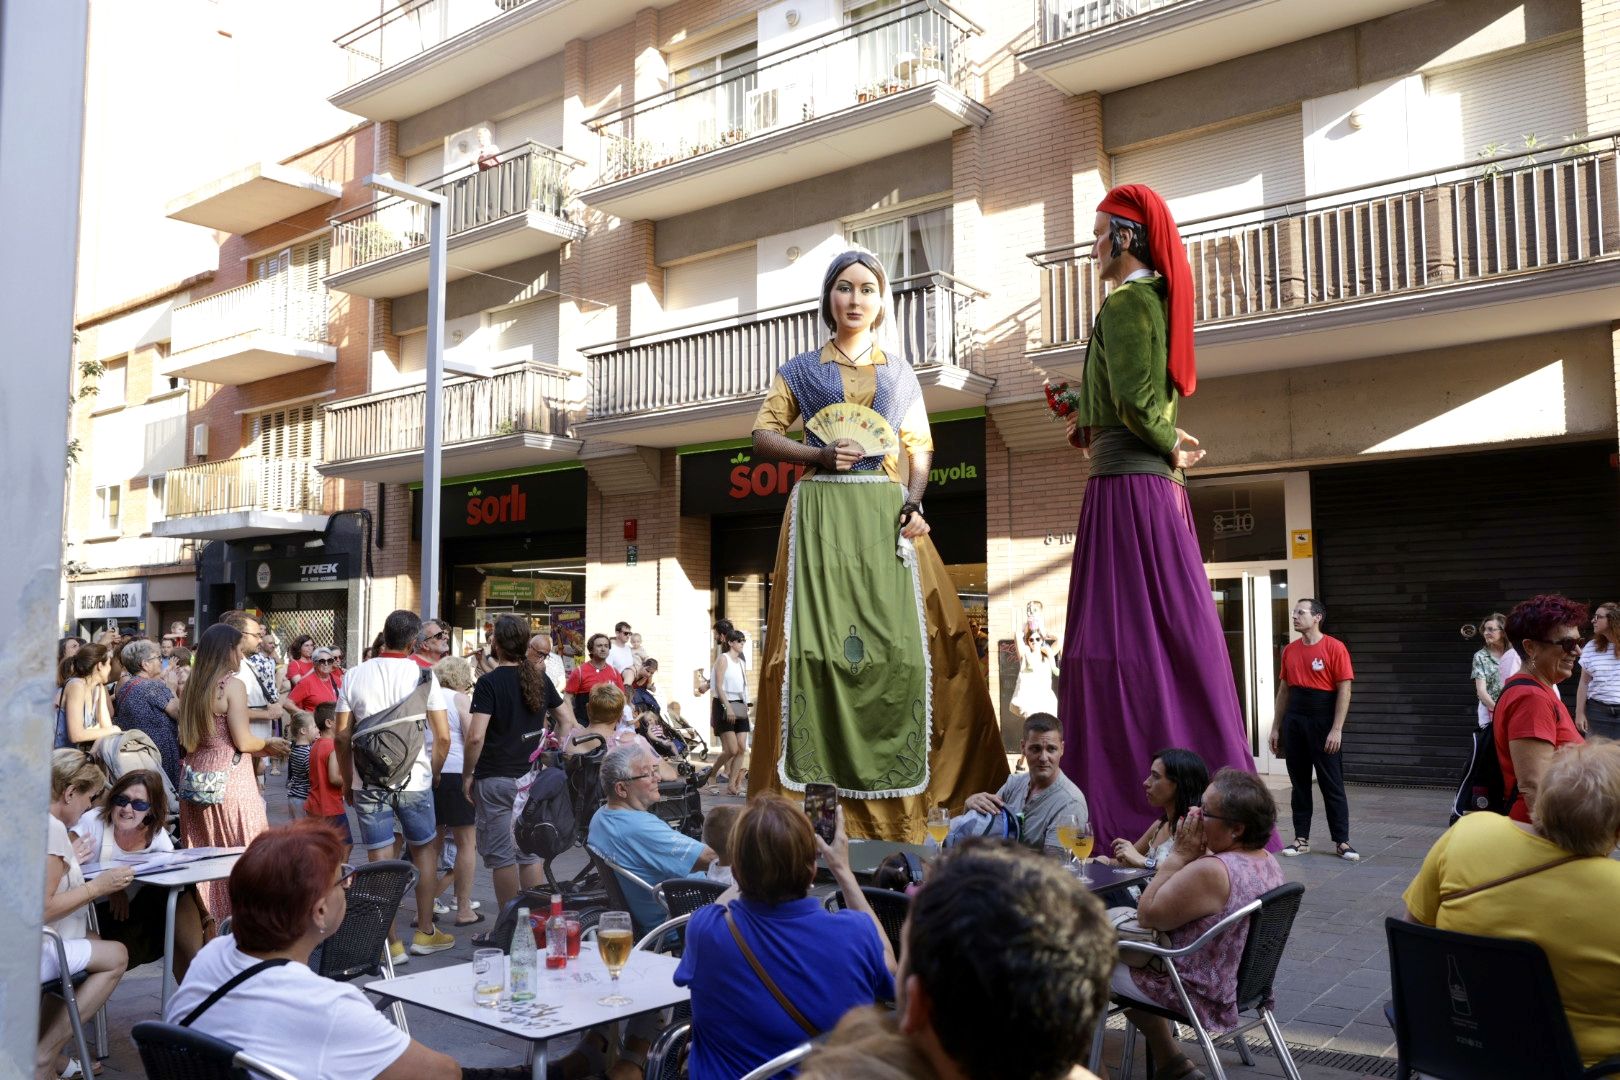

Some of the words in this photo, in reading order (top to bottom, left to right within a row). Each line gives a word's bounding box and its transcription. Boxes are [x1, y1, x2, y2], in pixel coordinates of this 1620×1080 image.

[466, 484, 527, 525] sorli
[1213, 513, 1254, 533] 8-10
[300, 563, 339, 574] TREK
